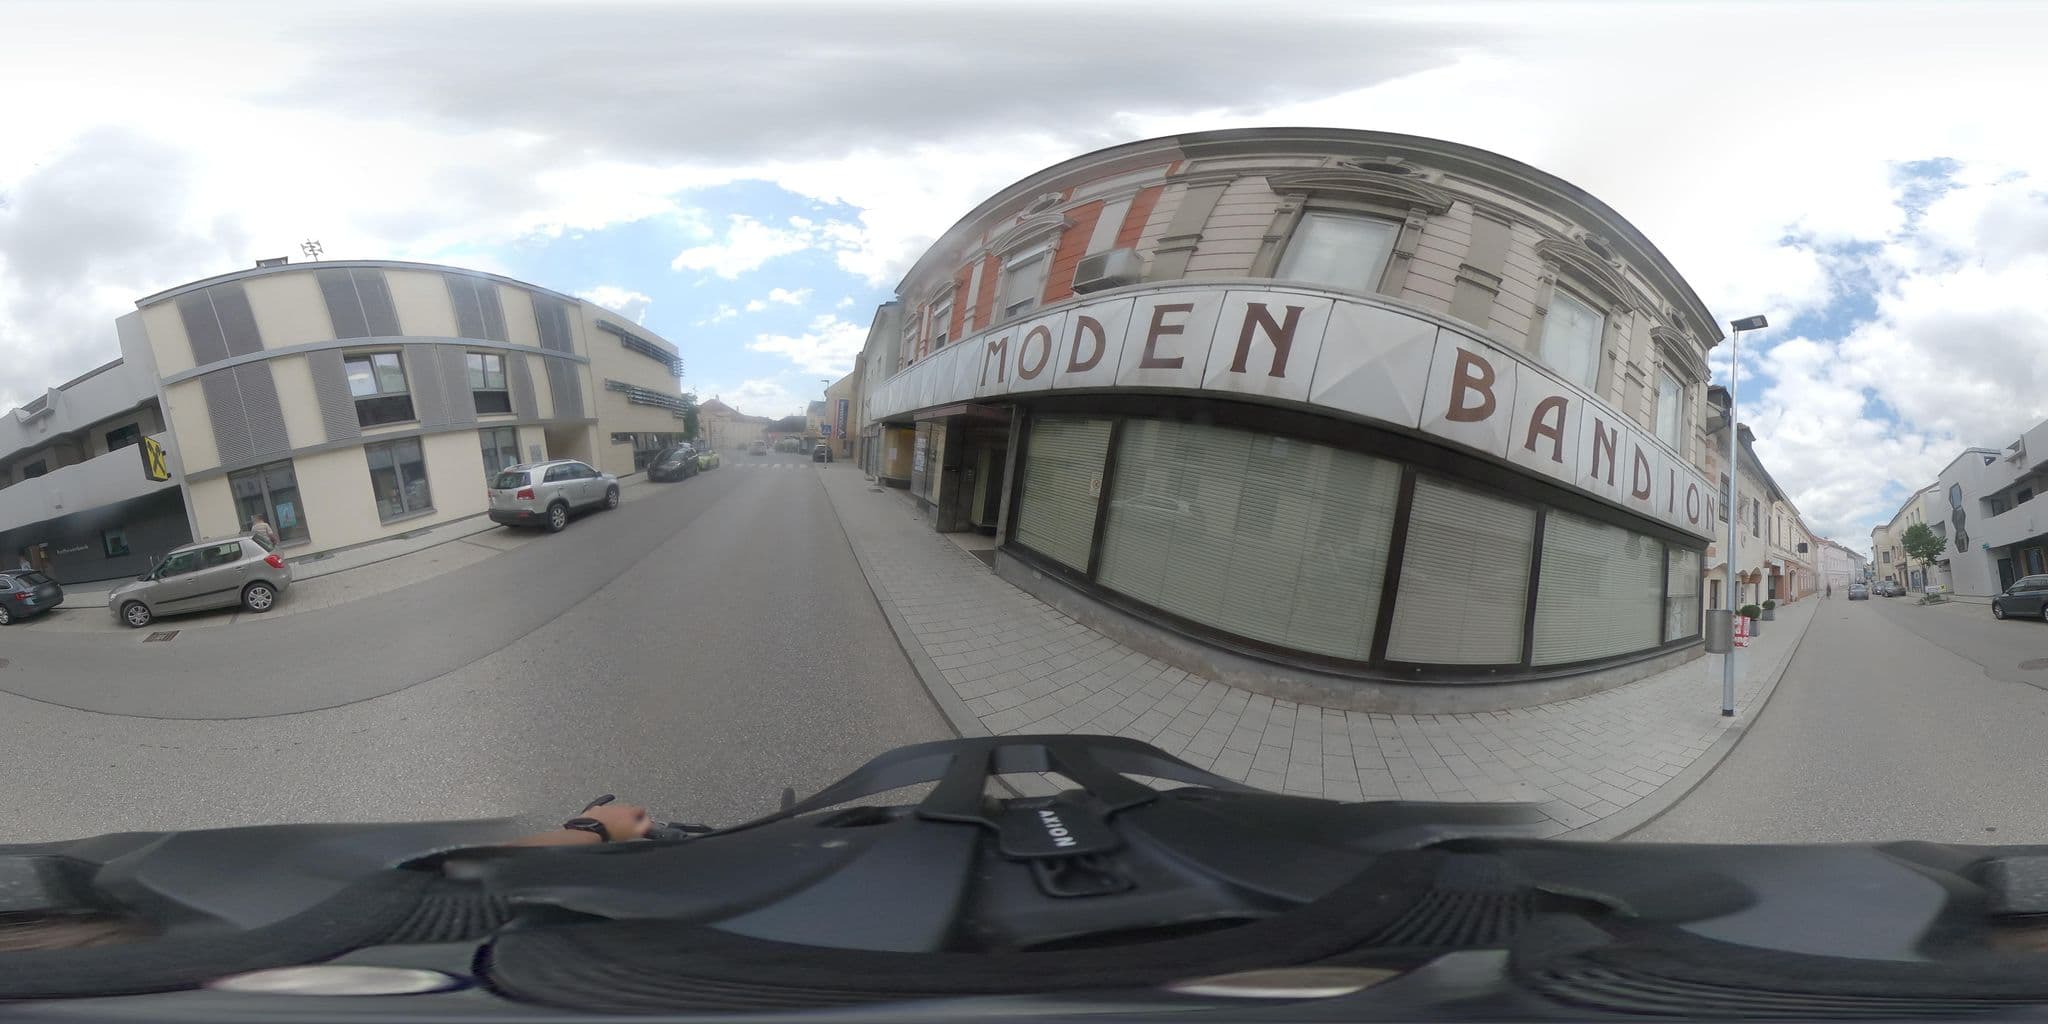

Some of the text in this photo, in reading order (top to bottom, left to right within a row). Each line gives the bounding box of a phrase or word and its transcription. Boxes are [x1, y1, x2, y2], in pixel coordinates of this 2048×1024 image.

[980, 302, 1715, 532] MODEN BANDION
[1038, 809, 1077, 848] AXION
